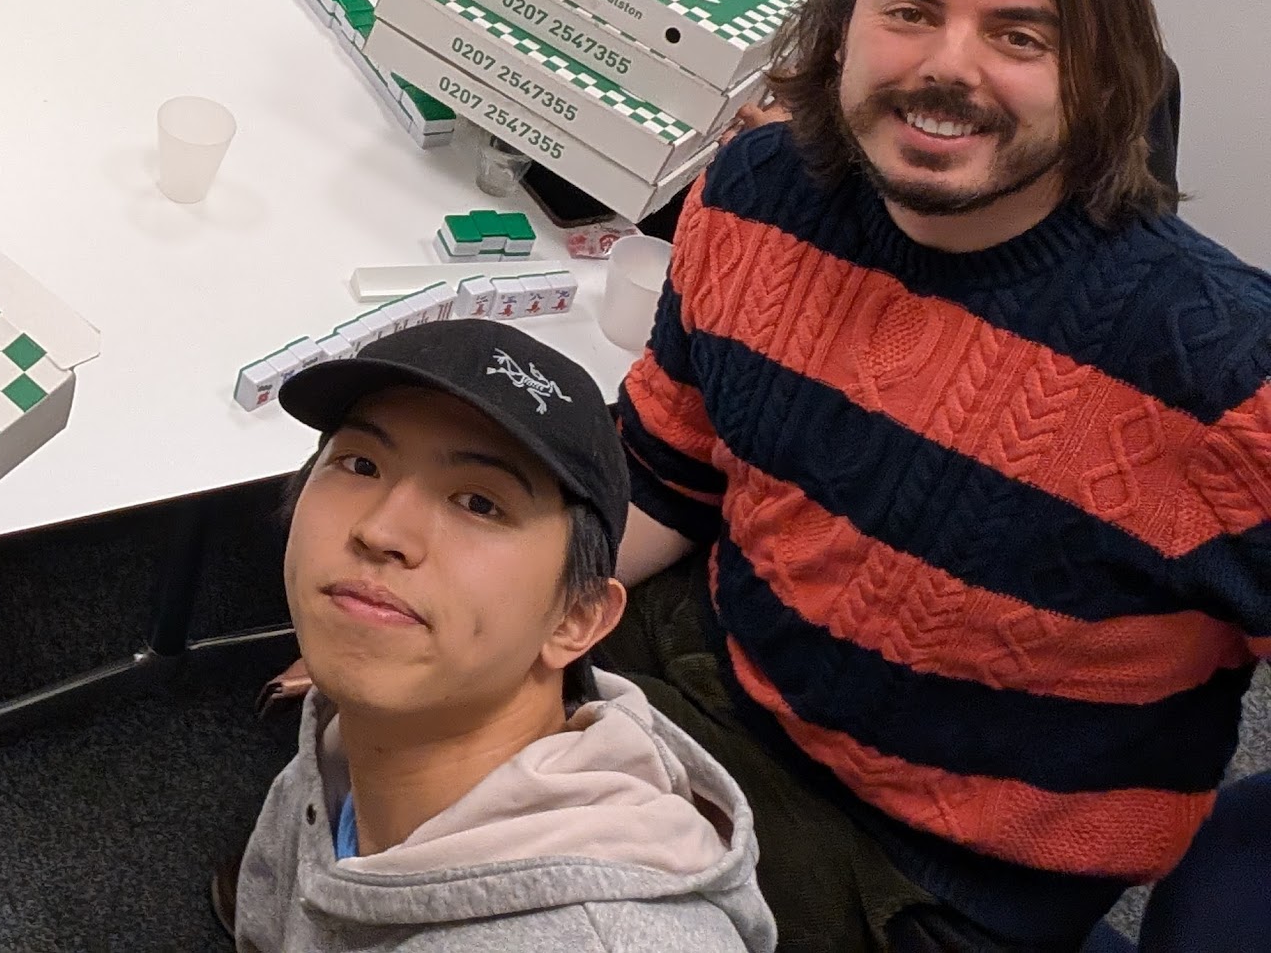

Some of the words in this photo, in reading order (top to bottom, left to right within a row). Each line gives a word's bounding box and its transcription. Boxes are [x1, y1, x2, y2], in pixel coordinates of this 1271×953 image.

[451, 37, 497, 71] 0207
[497, 65, 578, 121] 2547355
[549, 19, 632, 74] 2547355
[438, 76, 482, 110] 0207
[483, 103, 565, 160] 2547355
